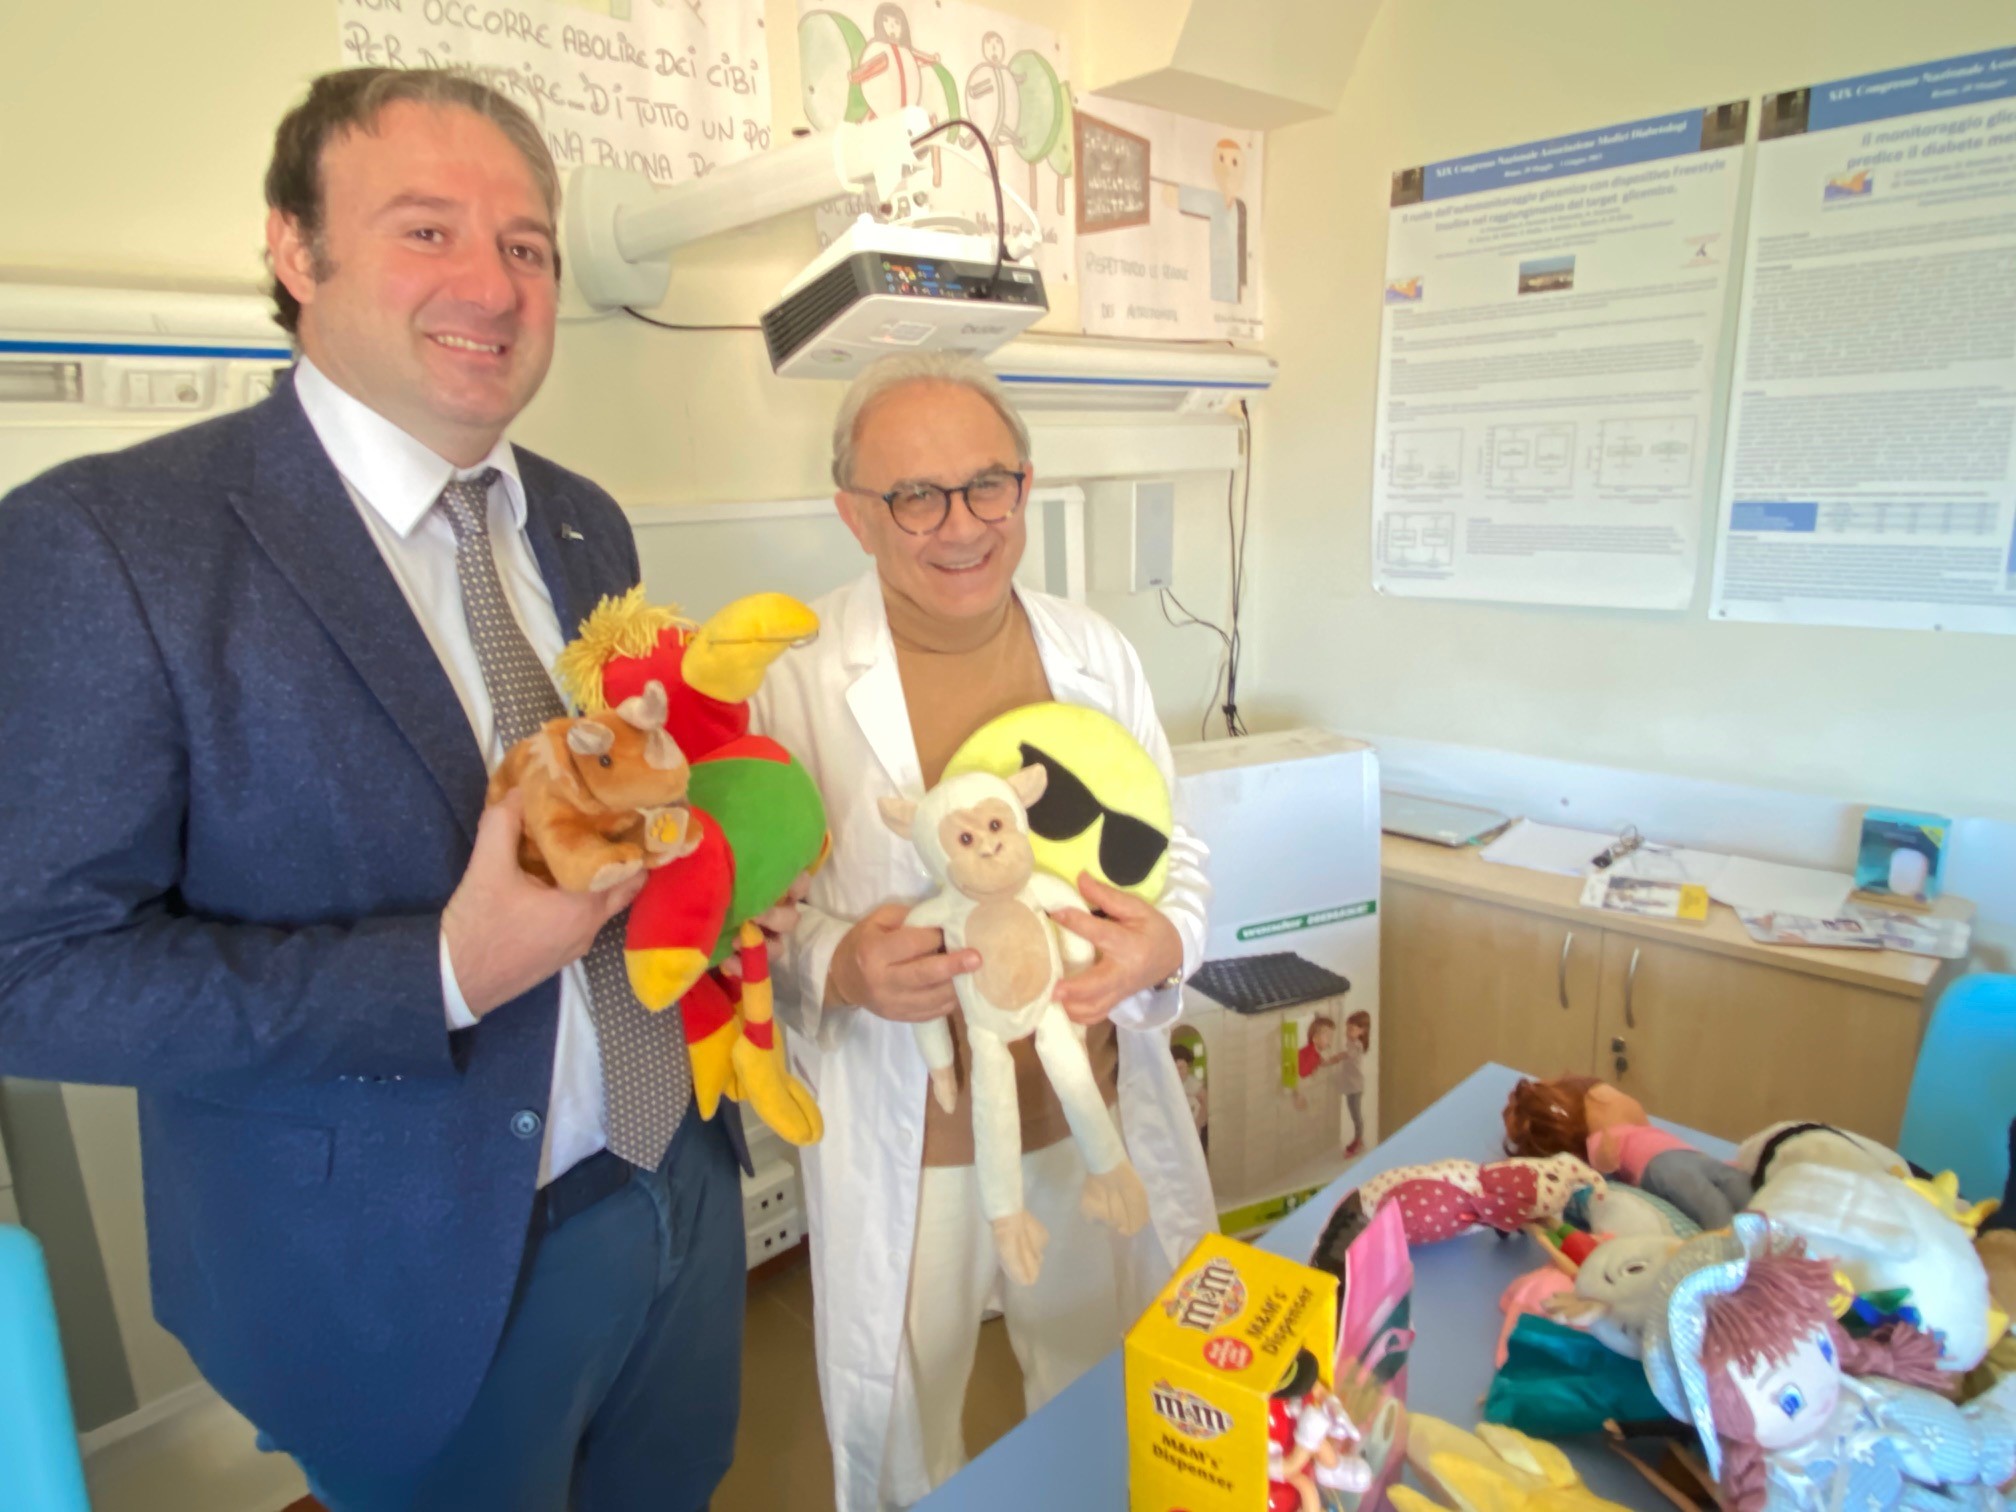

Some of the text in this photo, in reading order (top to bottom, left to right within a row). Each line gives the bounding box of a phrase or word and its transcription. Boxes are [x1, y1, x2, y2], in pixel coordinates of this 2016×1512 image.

[423, 0, 552, 49] OCCORRE
[344, 20, 408, 71] PER
[626, 96, 689, 131] TUTTO
[702, 117, 734, 142] UN
[1847, 149, 1904, 171] predice
[1908, 145, 1917, 158] il
[1921, 136, 1984, 157] diabete
[1875, 115, 1983, 144] monitoraggio
[591, 138, 674, 180] BUONA
[1261, 1287, 1315, 1356] Dispenser
[1153, 1444, 1235, 1493] Dispenser
